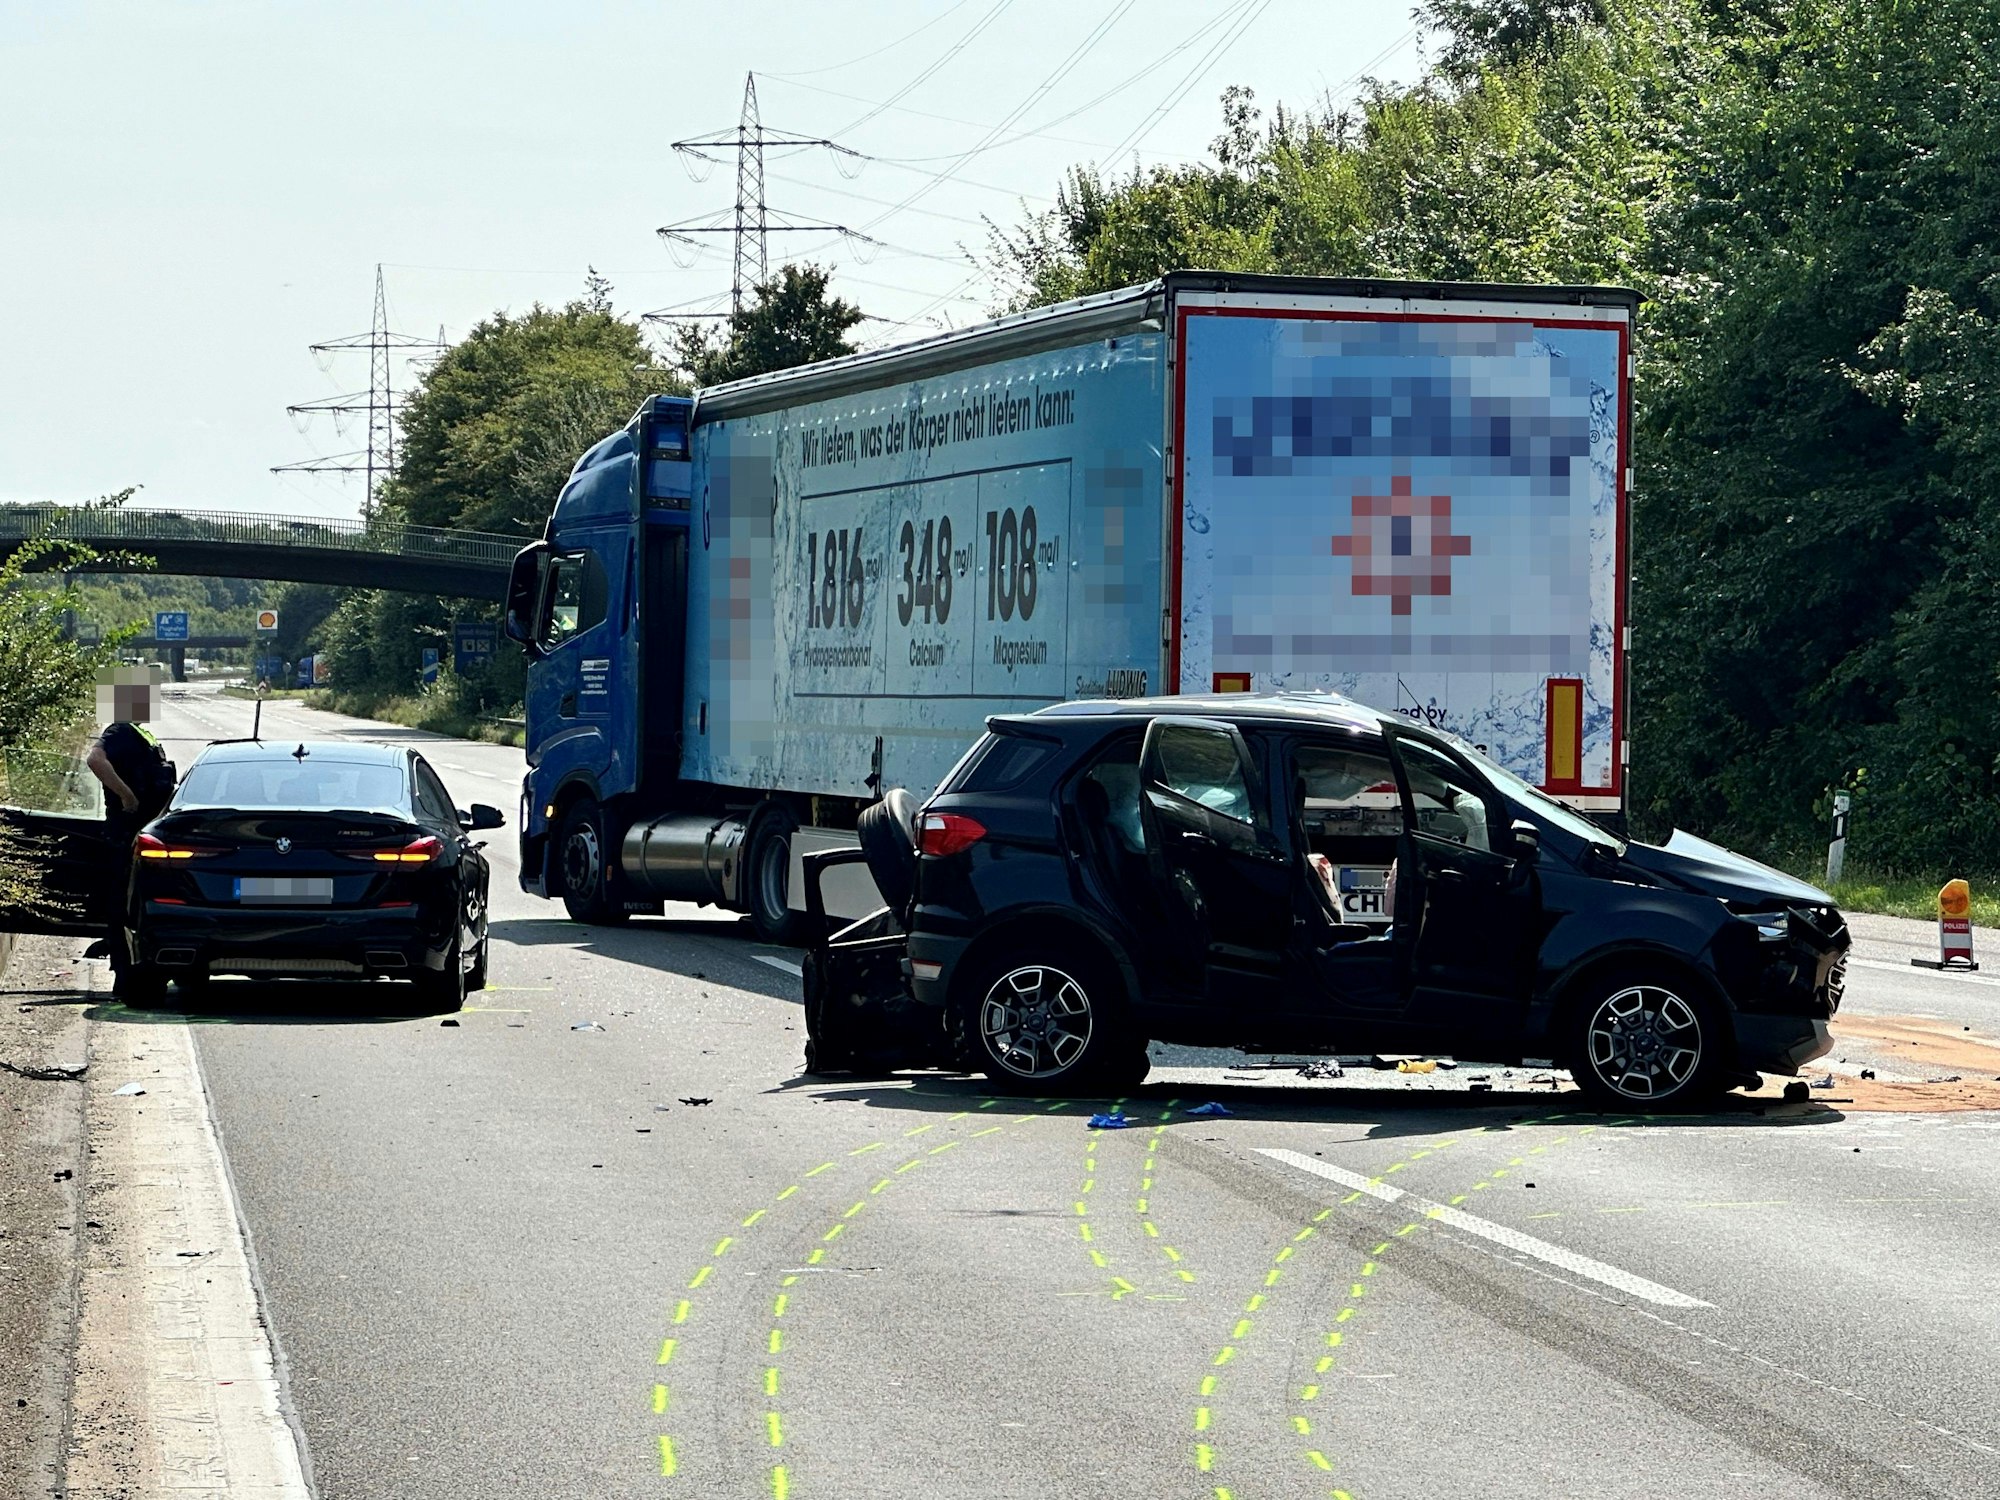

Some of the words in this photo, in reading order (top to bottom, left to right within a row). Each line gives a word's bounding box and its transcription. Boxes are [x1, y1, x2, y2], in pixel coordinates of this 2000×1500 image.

[802, 428, 820, 468] Wir
[821, 425, 857, 468] liefern,
[860, 425, 883, 458] was
[886, 413, 906, 455] der
[908, 405, 950, 457] Körper
[953, 395, 985, 443] nicht
[989, 390, 1031, 437] liefern
[1035, 385, 1075, 429] kann:
[808, 527, 864, 630] 1.816
[897, 515, 953, 627] 348
[954, 542, 973, 572] mg/l
[986, 505, 1037, 622] 108
[1039, 535, 1060, 566] mg/l
[803, 639, 872, 675] Hydrogencarbonat
[909, 638, 944, 667] Calcium
[993, 634, 1048, 674] Magnesium
[1105, 669, 1148, 698] LUDWIG
[1427, 705, 1447, 722] by
[623, 902, 653, 910] IVECO
[1943, 922, 1969, 930] POLIZEI
